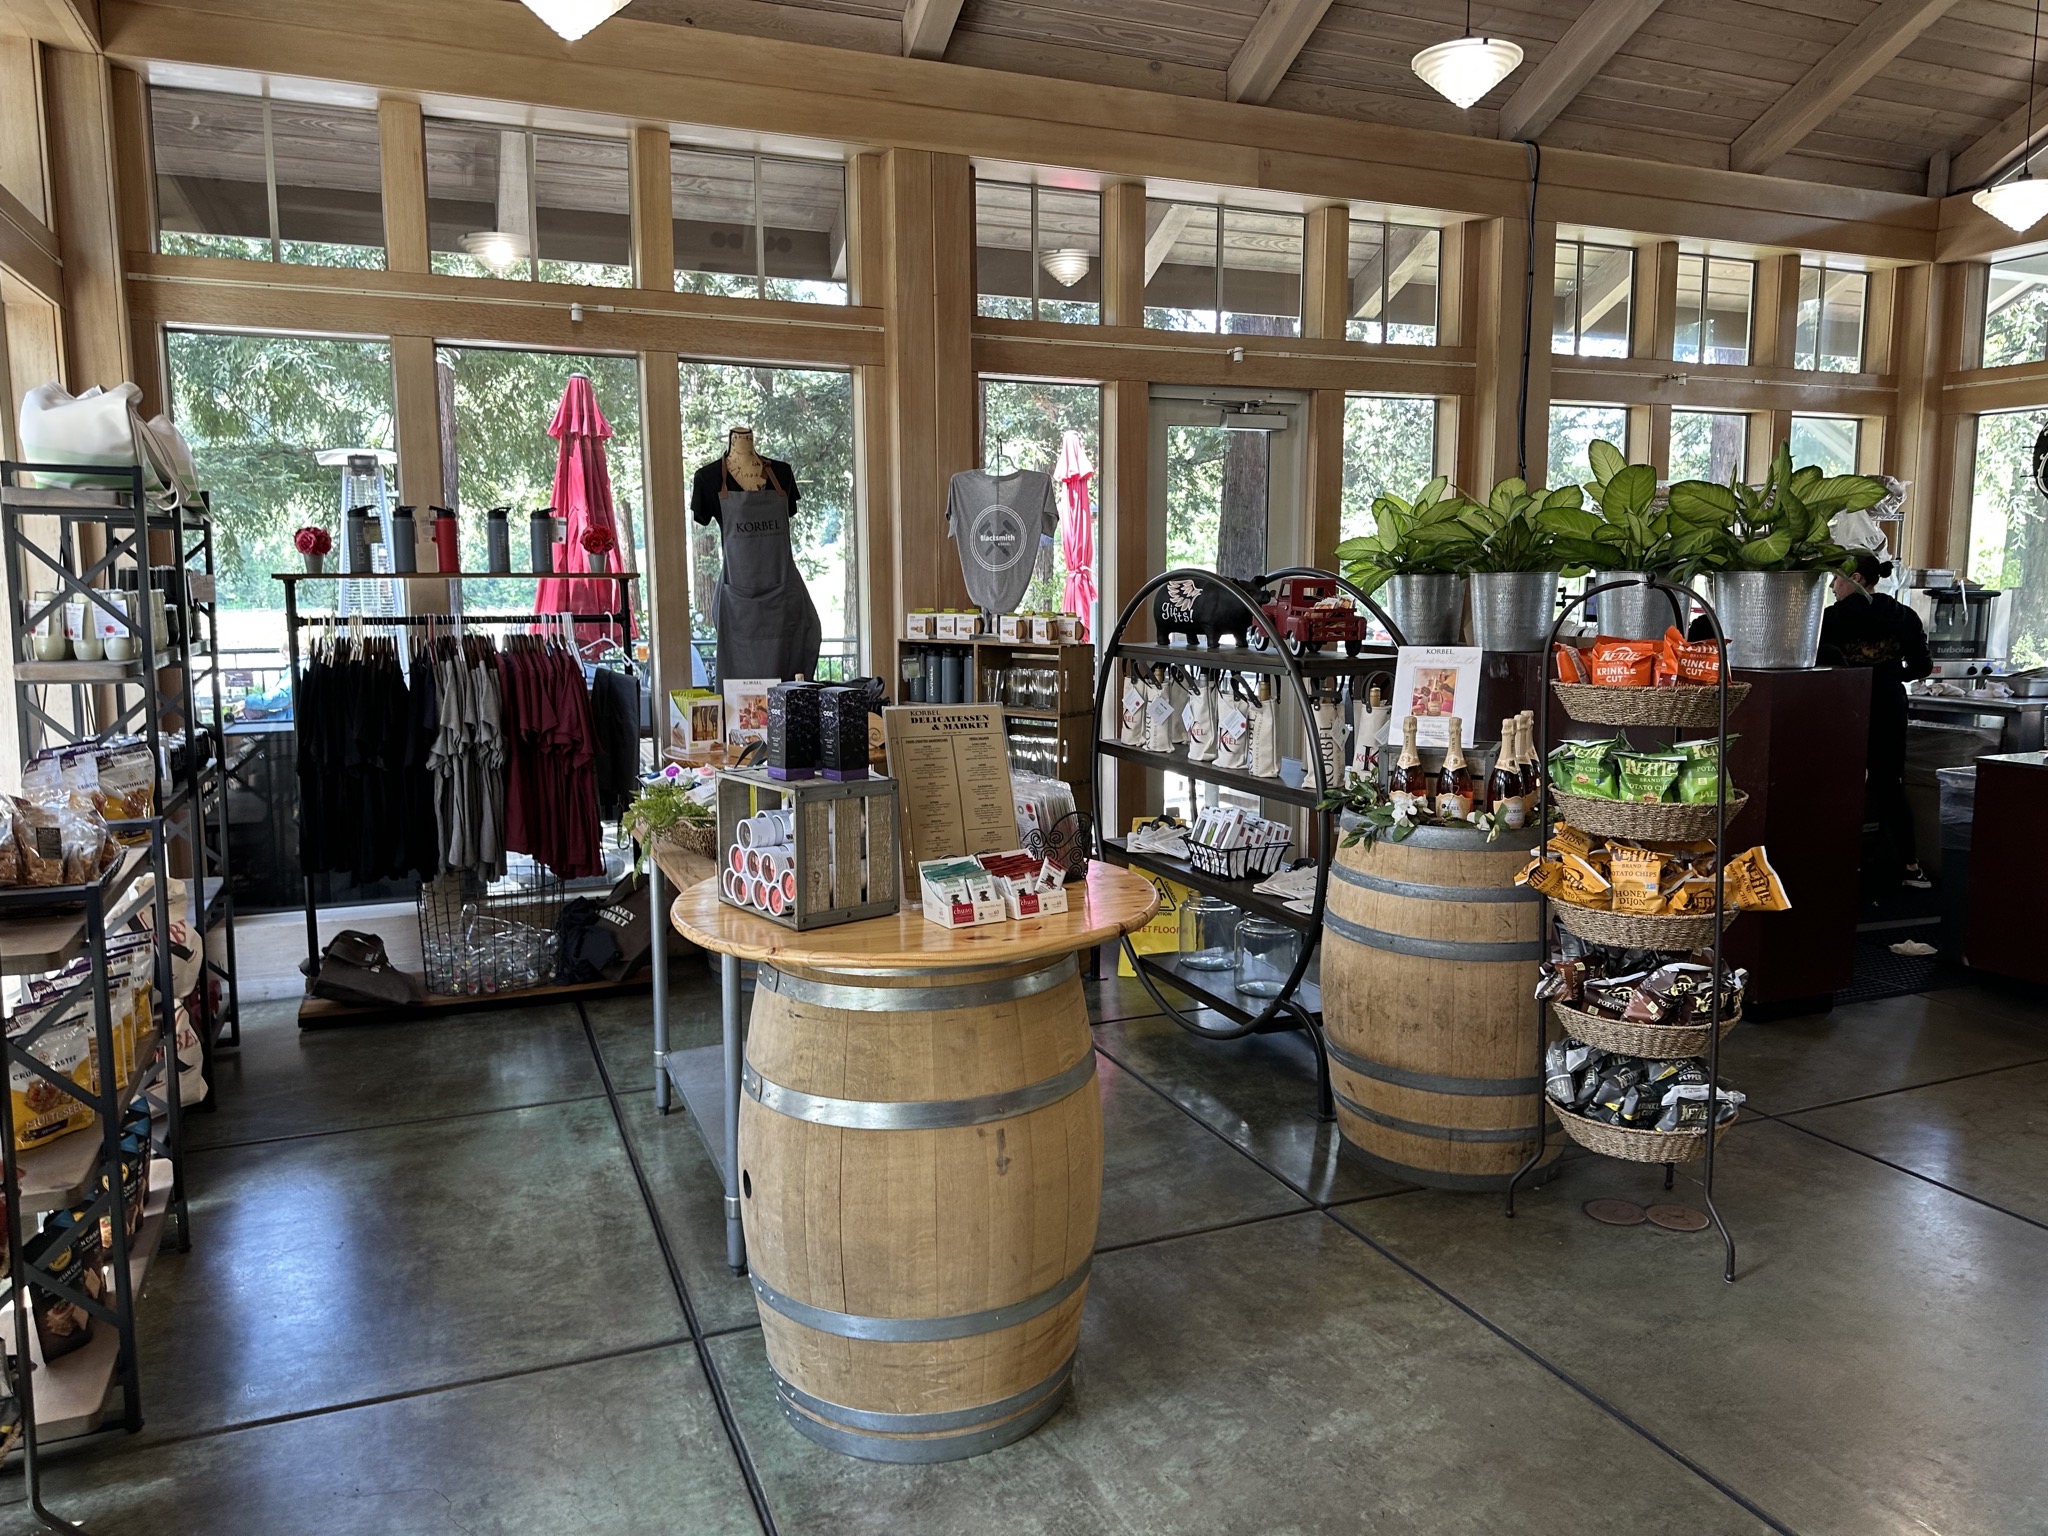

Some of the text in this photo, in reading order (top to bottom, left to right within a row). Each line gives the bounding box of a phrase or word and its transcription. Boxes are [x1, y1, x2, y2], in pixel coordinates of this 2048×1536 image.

[736, 519, 781, 533] KORBEL
[980, 533, 1016, 542] Blacksmith
[1161, 602, 1194, 623] gifts!
[1937, 645, 1975, 654] turbofan
[1681, 658, 1720, 671] RINKLE
[1597, 667, 1637, 676] KRINKLE
[1686, 667, 1703, 676] CUT
[1606, 675, 1622, 683] CUT
[911, 714, 990, 724] DELICATESSEN
[943, 721, 990, 731] MARKET
[1320, 722, 1335, 787] KORBEL
[1626, 758, 1679, 777] KETTLE
[1747, 856, 1773, 906] KETTLE
[1164, 880, 1178, 903] CUIDADO
[1615, 890, 1648, 898] HONEY
[1020, 898, 1038, 907] chuao
[1619, 898, 1646, 906] DIJON
[953, 907, 973, 916] chuao
[1597, 998, 1625, 1013] POTATO
